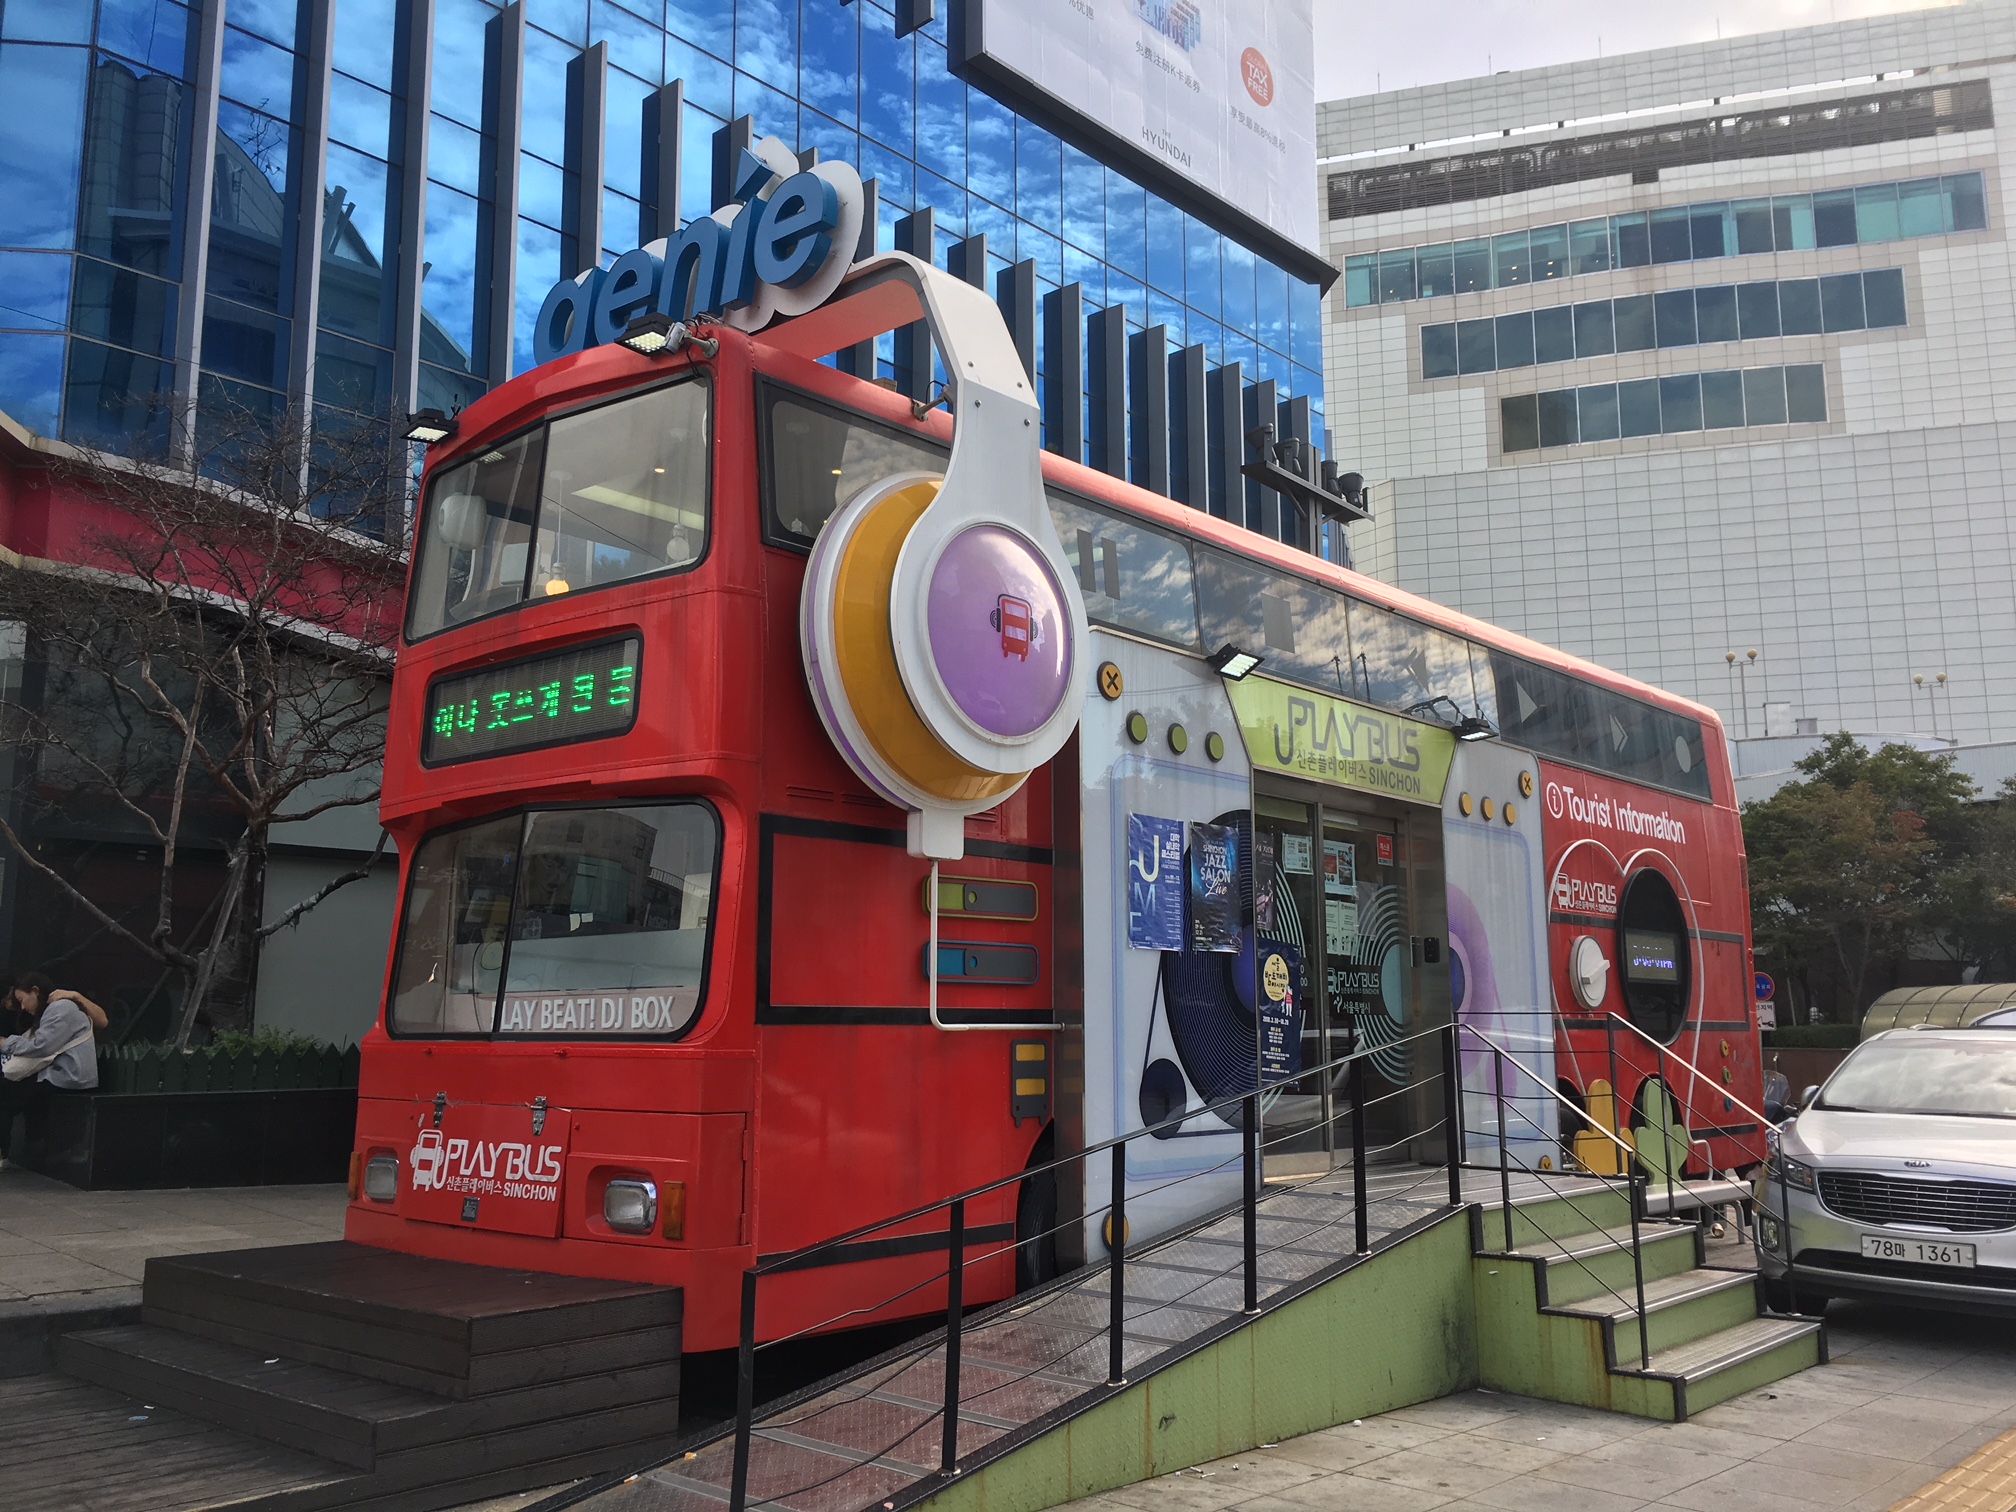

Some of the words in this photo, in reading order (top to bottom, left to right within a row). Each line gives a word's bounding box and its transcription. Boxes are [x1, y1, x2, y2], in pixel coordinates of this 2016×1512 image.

[1246, 60, 1268, 88] TAX
[1247, 77, 1269, 101] FREE
[1142, 126, 1191, 168] HYUNDAI
[1274, 695, 1420, 772] PLAYBUS
[1296, 749, 1367, 781] 신촌플레이버스
[1369, 769, 1421, 794] SINCHON
[1562, 785, 1613, 828] Tourist
[1613, 799, 1687, 844] Information
[1204, 853, 1227, 869] JAZZ
[1200, 867, 1231, 883] SALON
[1205, 876, 1228, 898] Live
[1568, 879, 1617, 908] PLAYBUS
[1335, 971, 1380, 994] PLAYBUS
[541, 998, 596, 1030] BEAT!
[602, 997, 624, 1030] DJ
[631, 995, 676, 1029] BOX
[1342, 1001, 1371, 1014] 서울특별시
[434, 1138, 562, 1189] PLAYBUS
[446, 1176, 502, 1195] 신촌플레이버스
[502, 1182, 557, 1202] SINCHON
[1871, 1239, 1906, 1258] 78마
[1916, 1244, 1961, 1264] 1361
